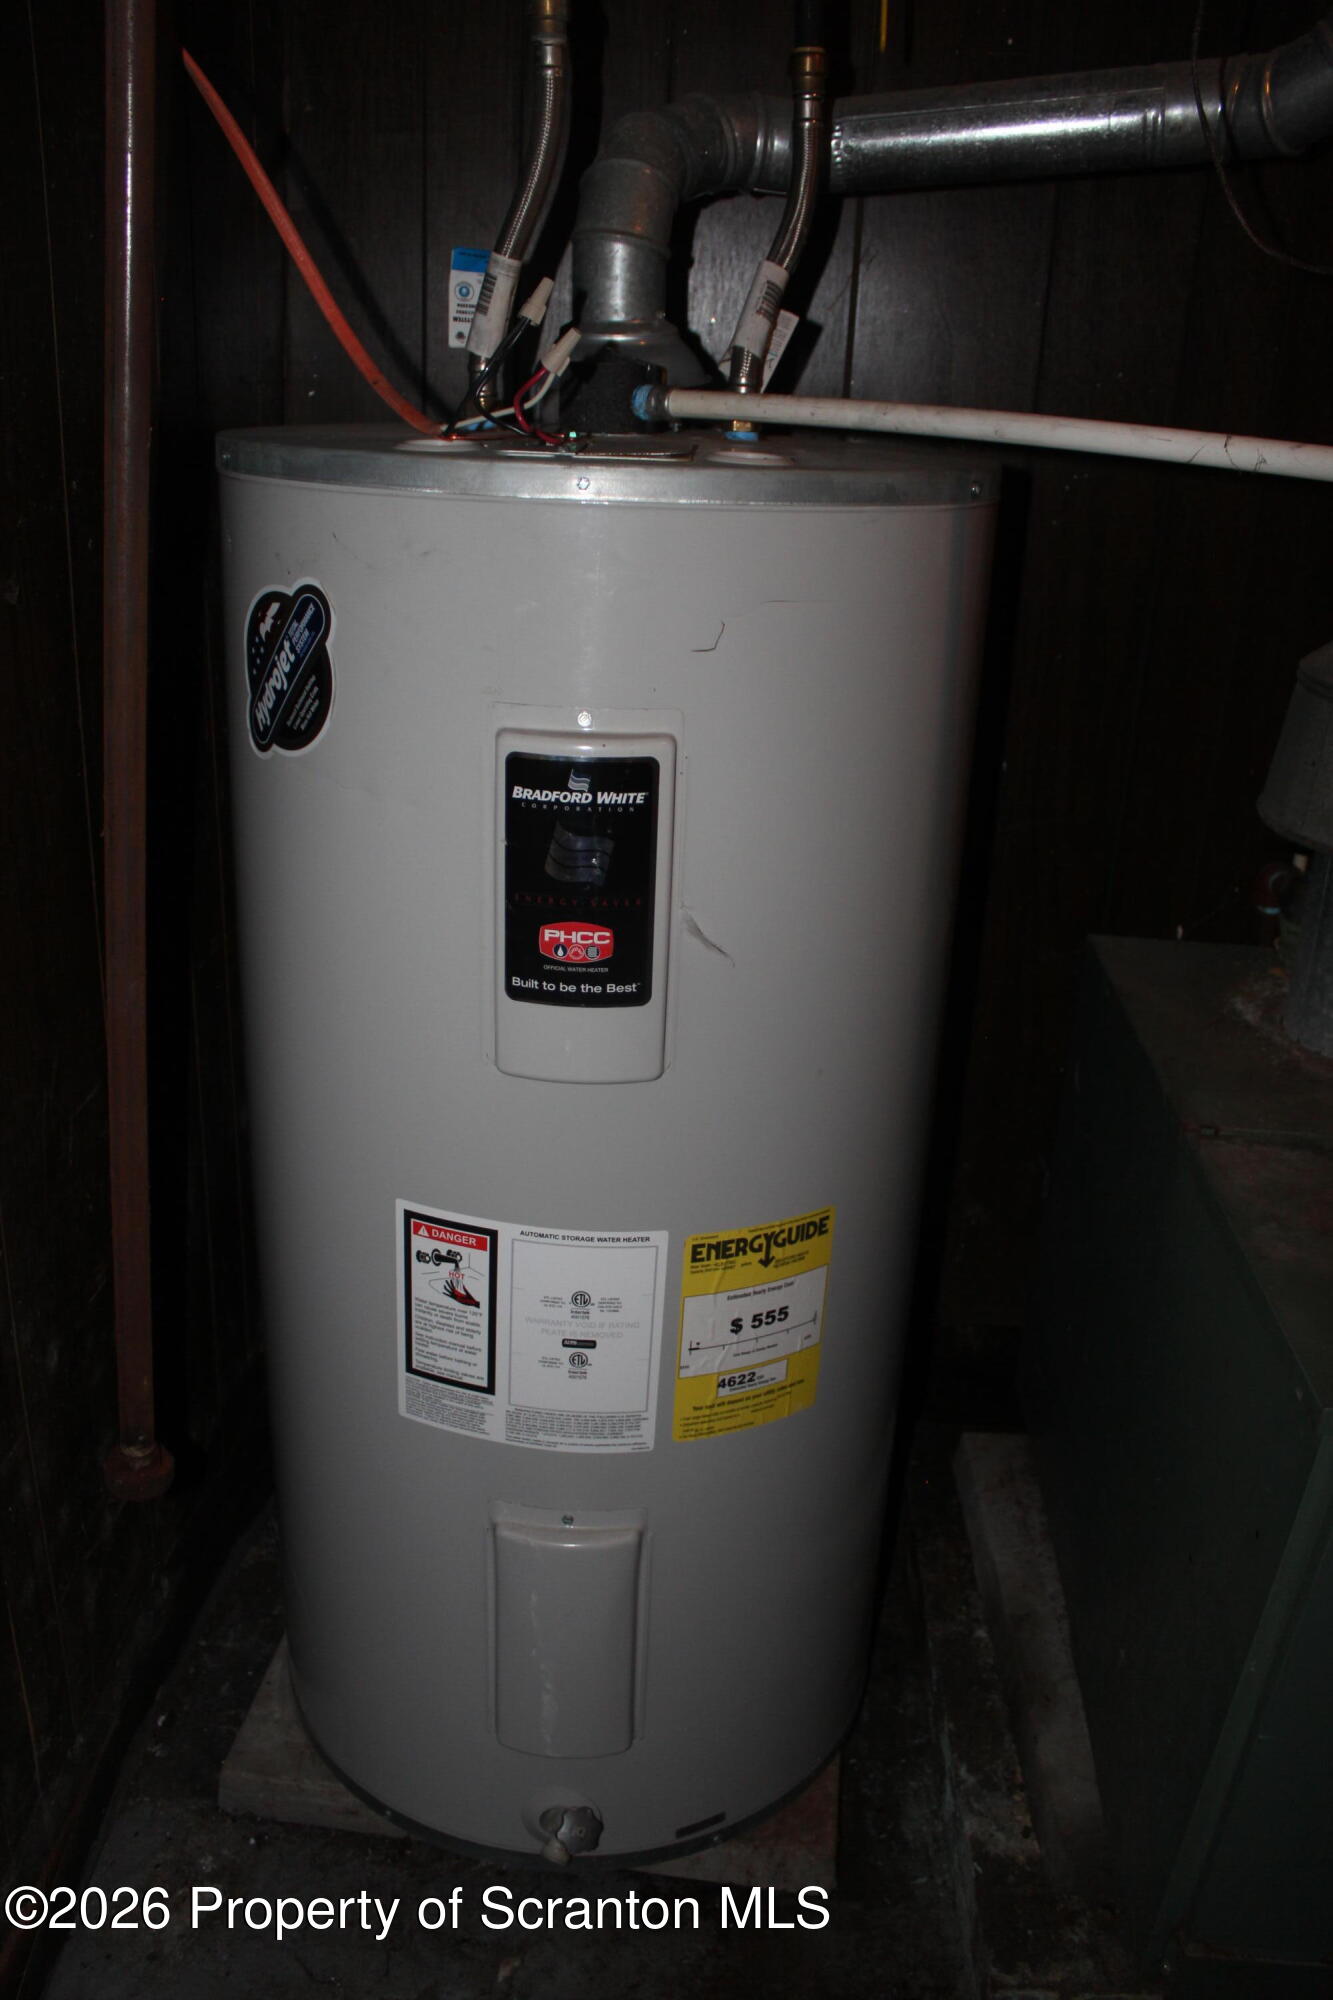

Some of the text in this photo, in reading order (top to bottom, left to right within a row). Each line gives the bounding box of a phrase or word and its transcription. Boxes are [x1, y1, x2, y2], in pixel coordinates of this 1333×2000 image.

[512, 786, 646, 804] BRADFORD WHITE
[522, 802, 634, 812] CORPORATION
[544, 929, 610, 944] PHCC
[512, 976, 638, 993] Built to be the Best
[432, 1229, 476, 1246] DANGER
[520, 1230, 560, 1240] AUTOMATIC
[690, 1216, 830, 1264] ENERGYGUIDE
[730, 1306, 789, 1334] $ 555
[717, 1372, 756, 1388] 4622
